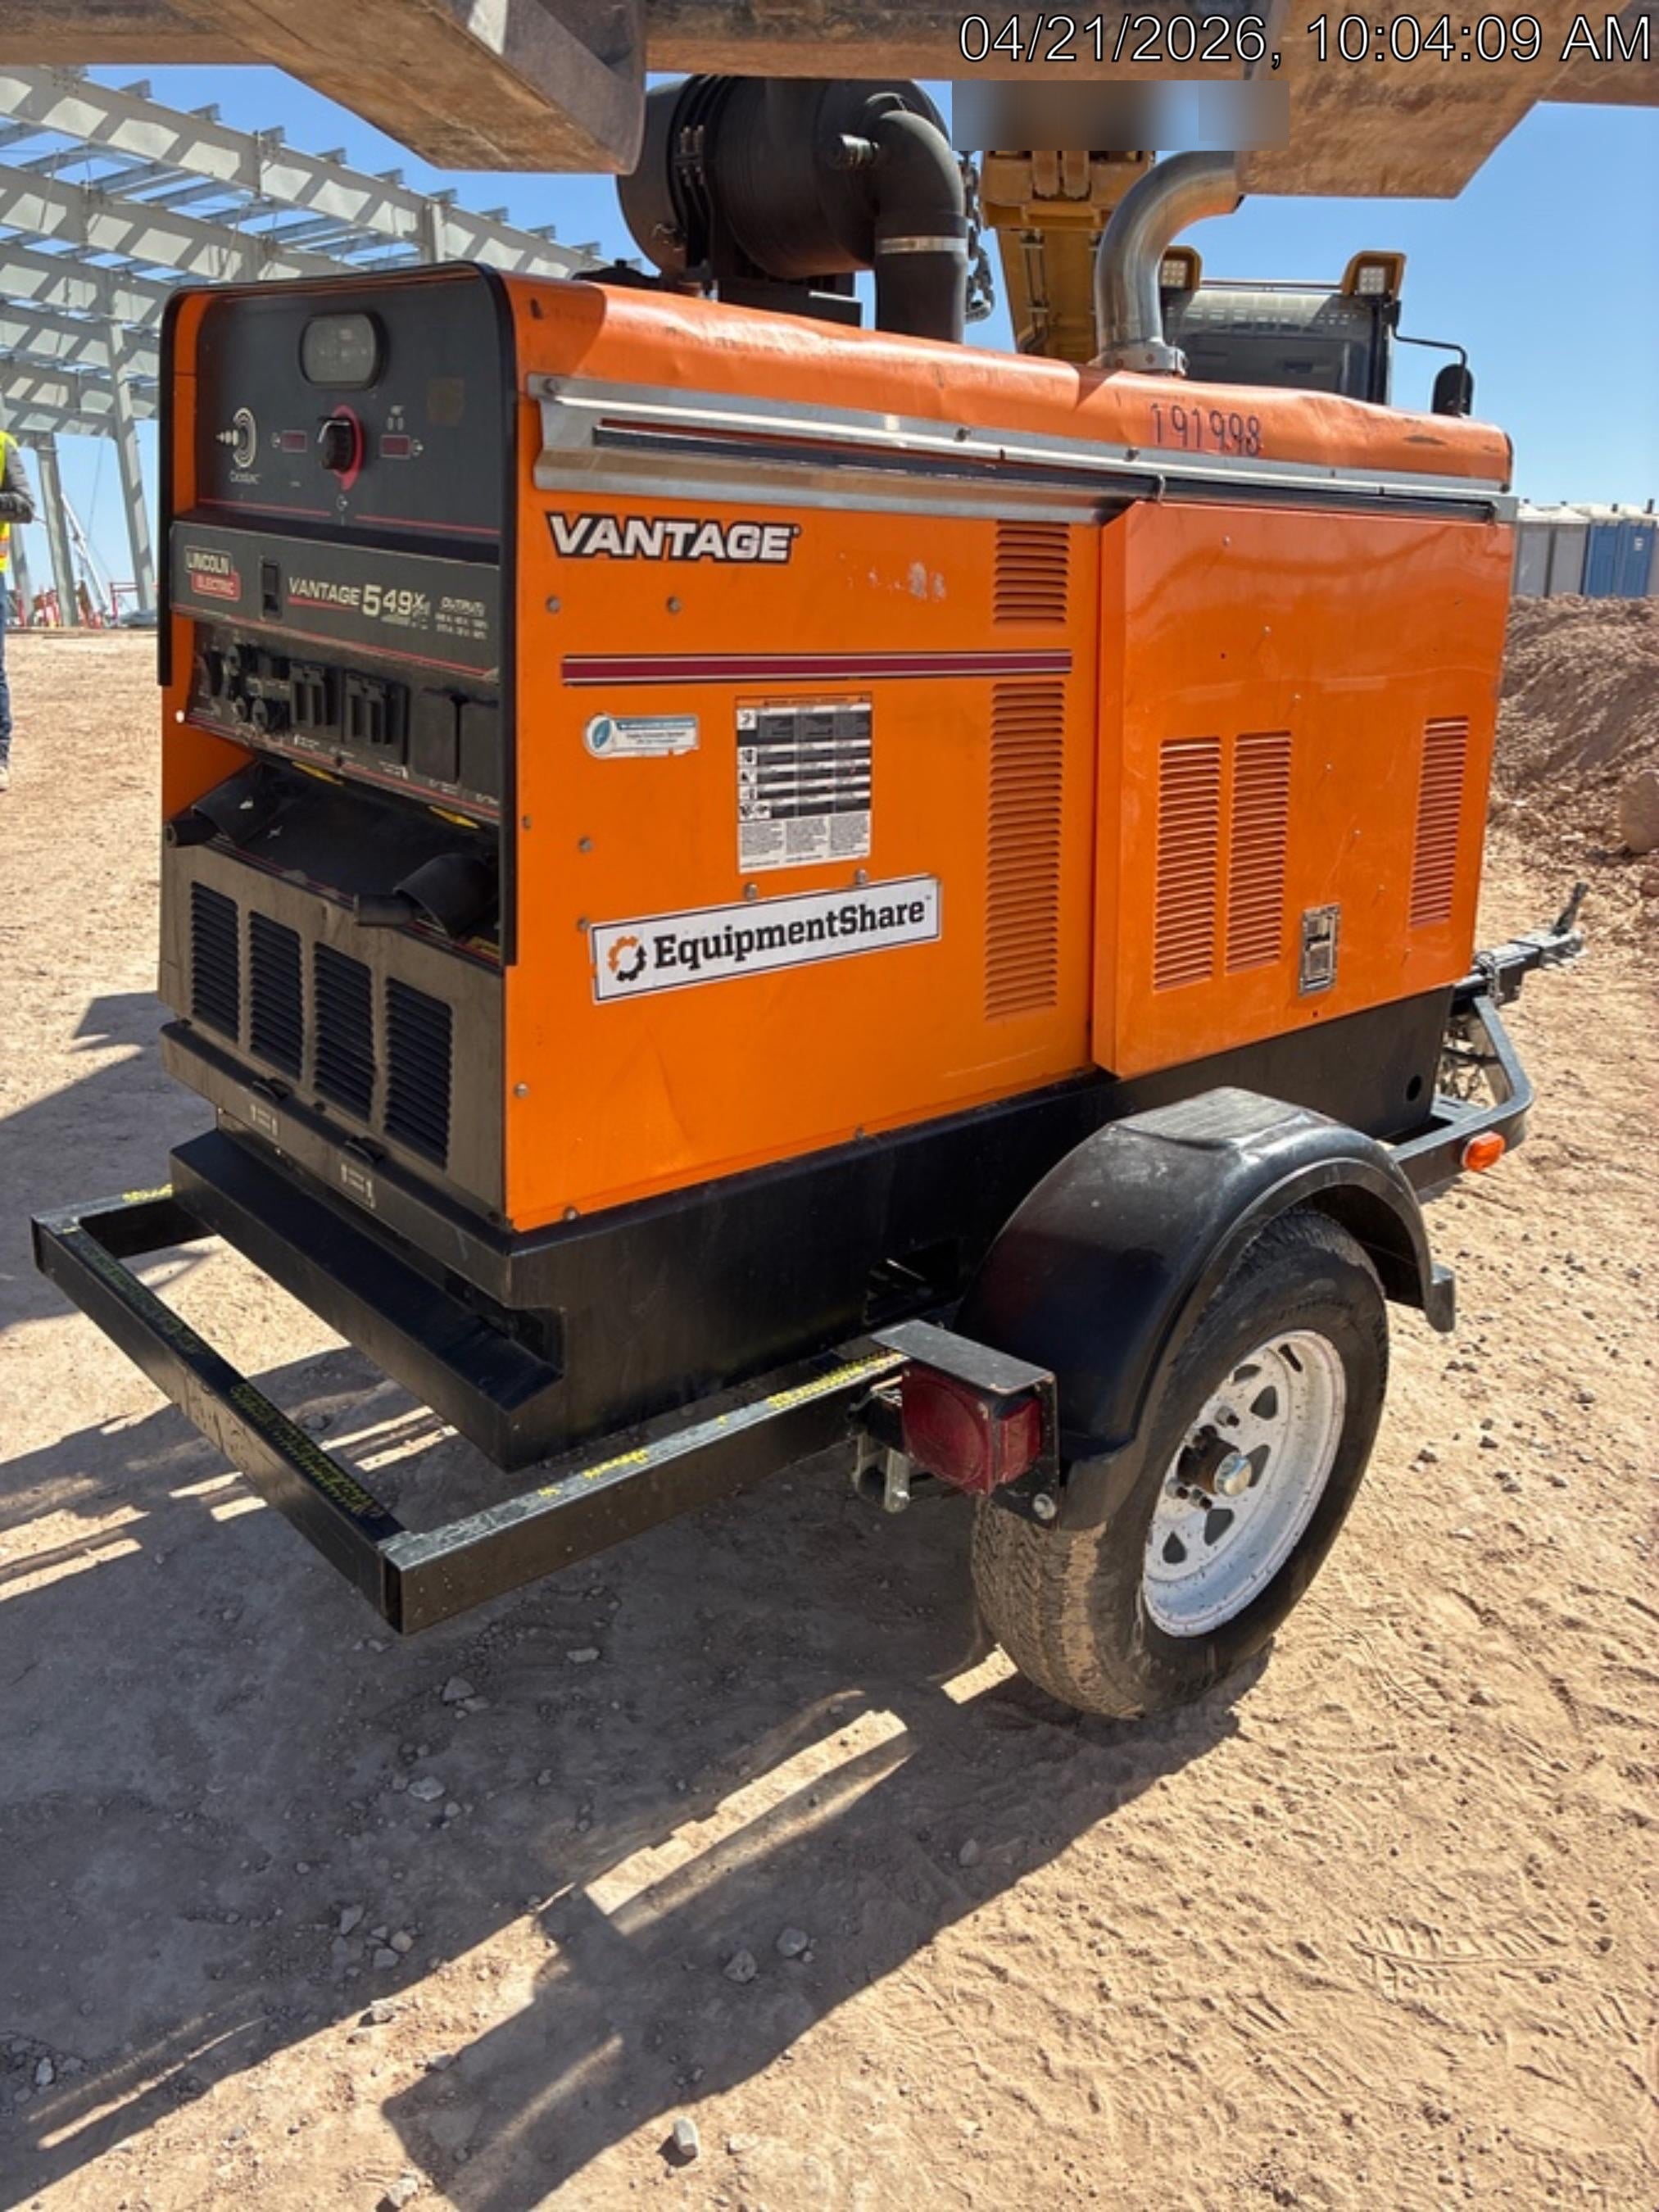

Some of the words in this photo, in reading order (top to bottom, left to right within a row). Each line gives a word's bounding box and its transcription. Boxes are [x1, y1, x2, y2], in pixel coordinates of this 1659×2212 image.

[1150, 403, 1259, 457] 191998
[547, 513, 793, 562] VANTAGE
[288, 577, 361, 606] VANTAGE
[655, 900, 925, 971] EquipmentShare
